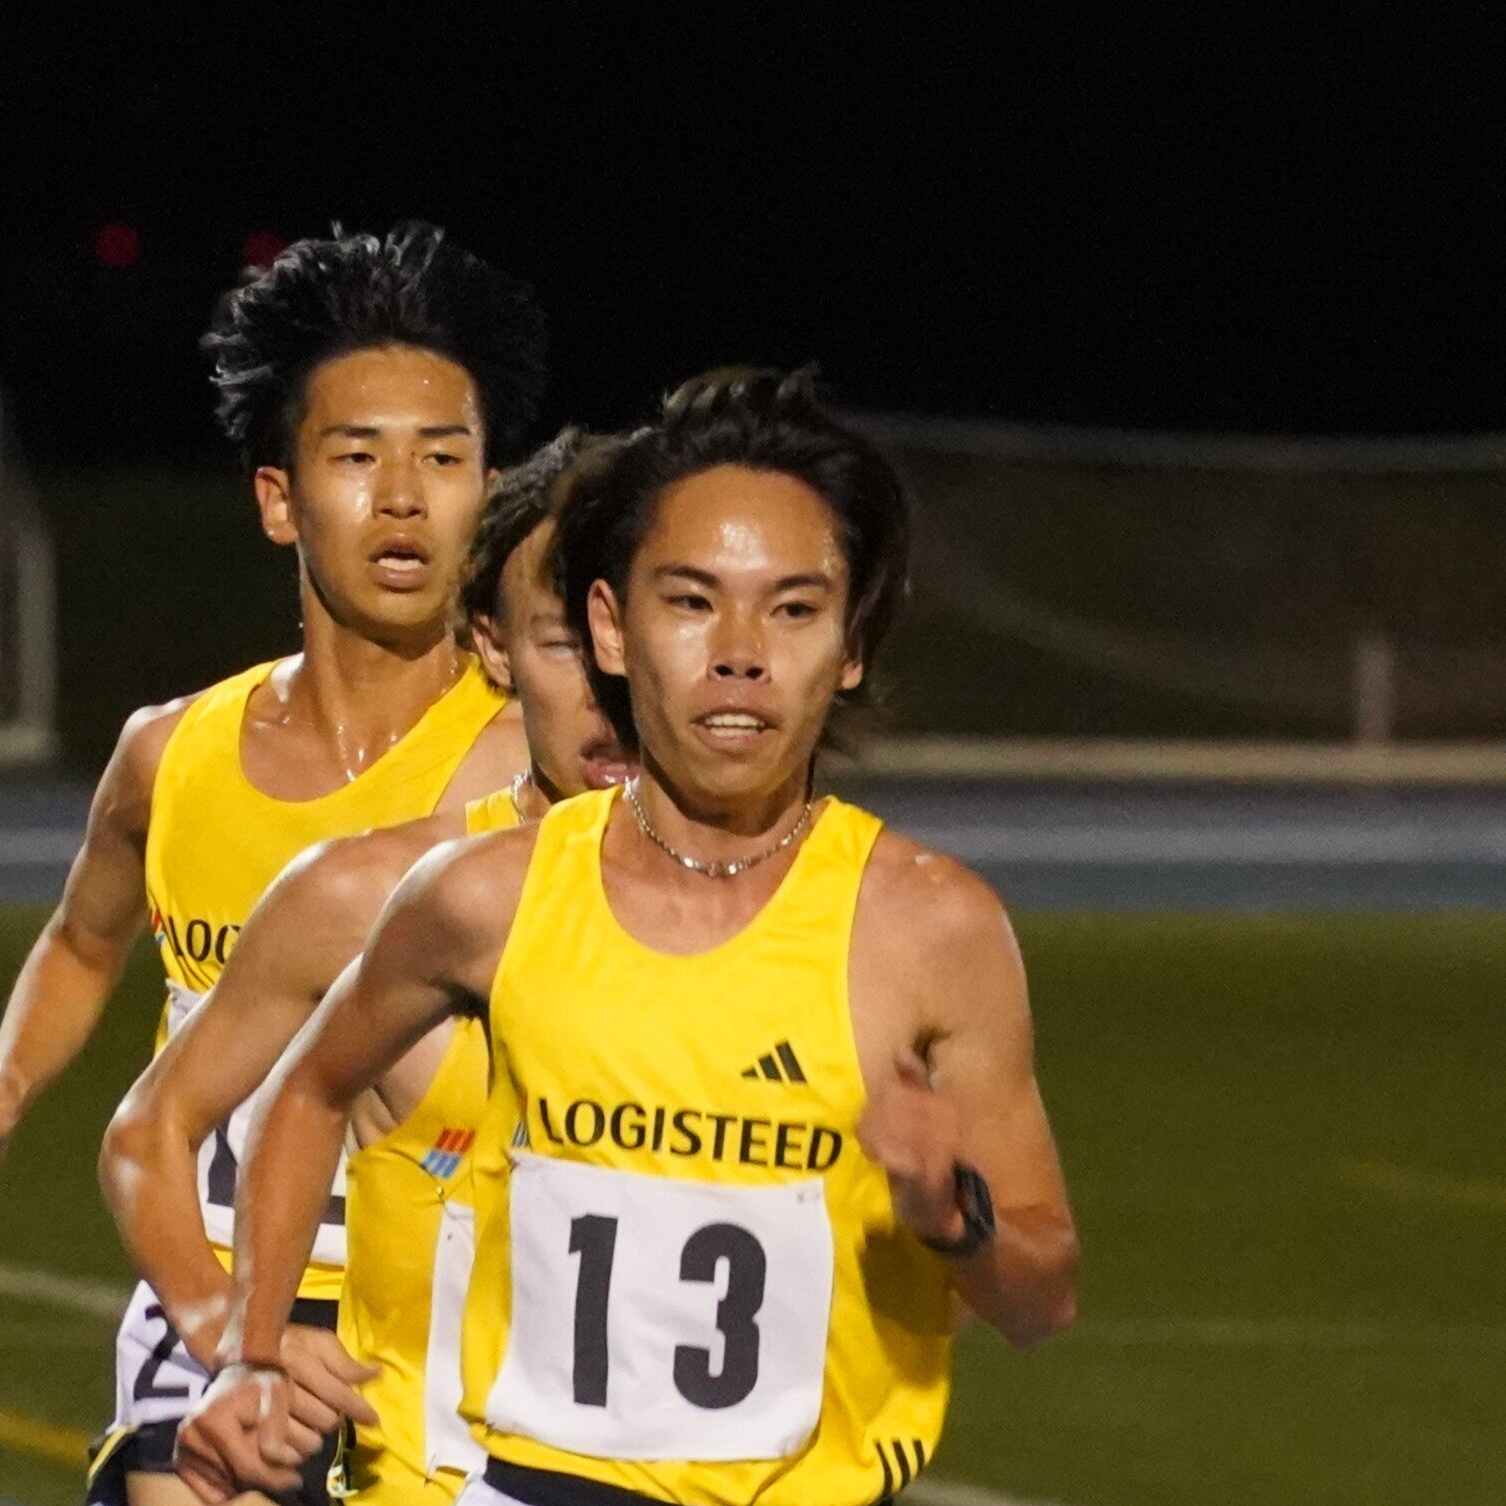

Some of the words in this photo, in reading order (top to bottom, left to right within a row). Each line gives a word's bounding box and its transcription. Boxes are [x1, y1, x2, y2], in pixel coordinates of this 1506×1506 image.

[537, 1096, 844, 1173] LOGISTEED
[133, 1303, 210, 1401] 2
[567, 1212, 768, 1410] 13
